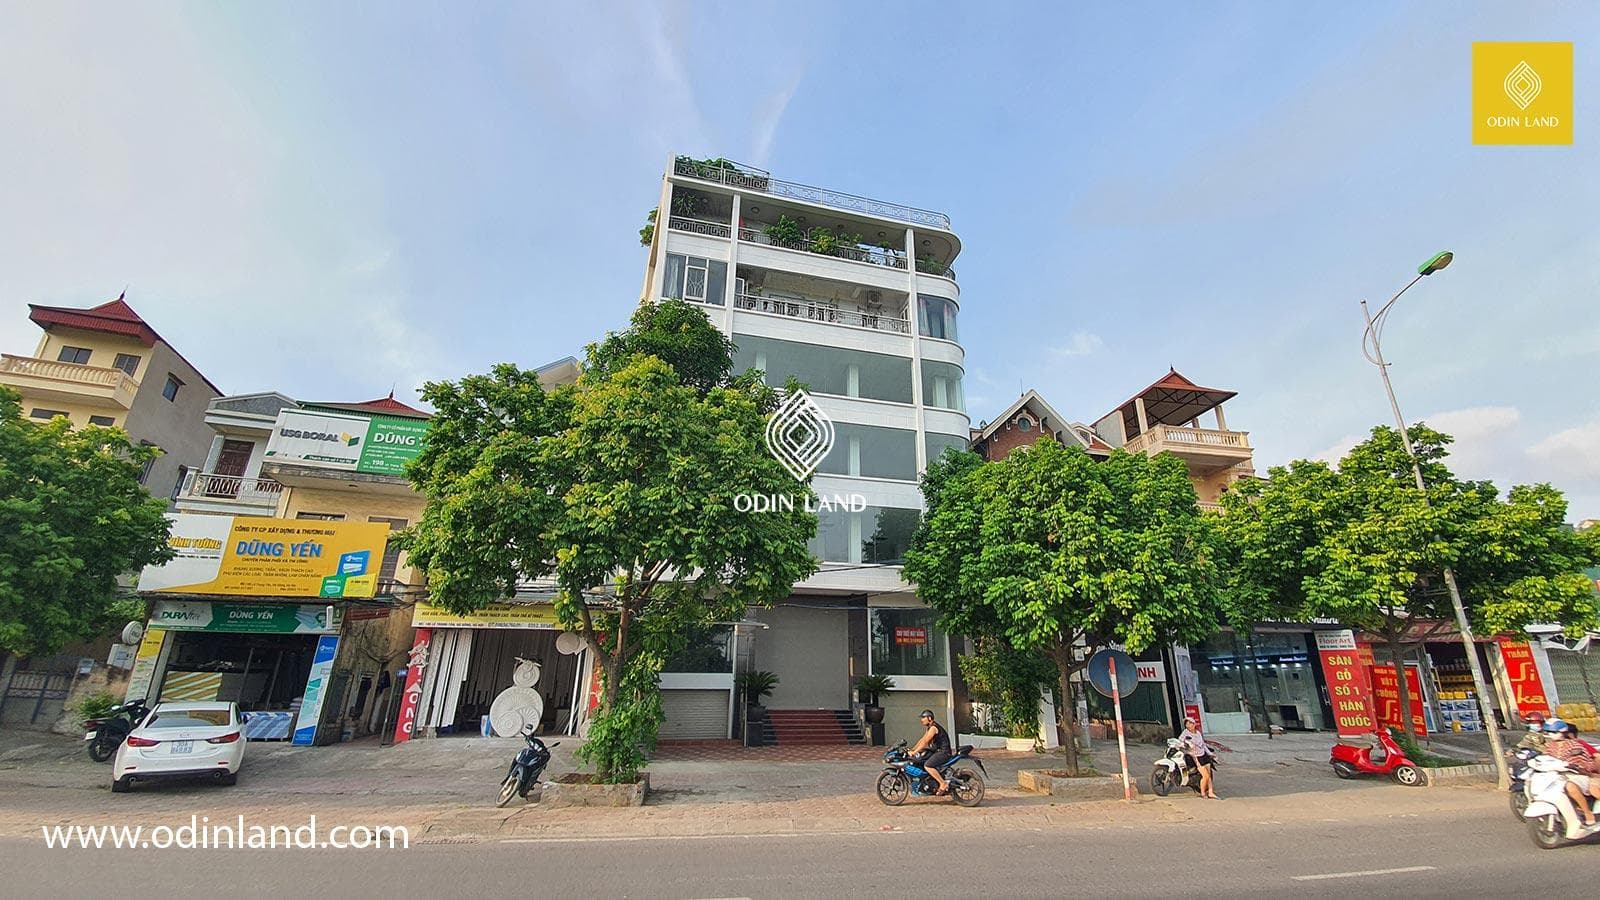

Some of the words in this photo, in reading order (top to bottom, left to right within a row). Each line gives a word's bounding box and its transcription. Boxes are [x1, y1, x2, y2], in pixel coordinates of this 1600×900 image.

[280, 428, 302, 438] USG
[302, 431, 339, 442] BORAL
[373, 432, 416, 446] DŨNG
[236, 539, 285, 556] DŨNG
[289, 539, 323, 557] YẾN
[229, 608, 254, 619] DŨNG
[257, 610, 274, 620] YẾN
[1137, 667, 1156, 678] NH
[1335, 683, 1351, 696] SỐ
[1353, 687, 1360, 695] 1
[1339, 713, 1372, 727] QUỐC
